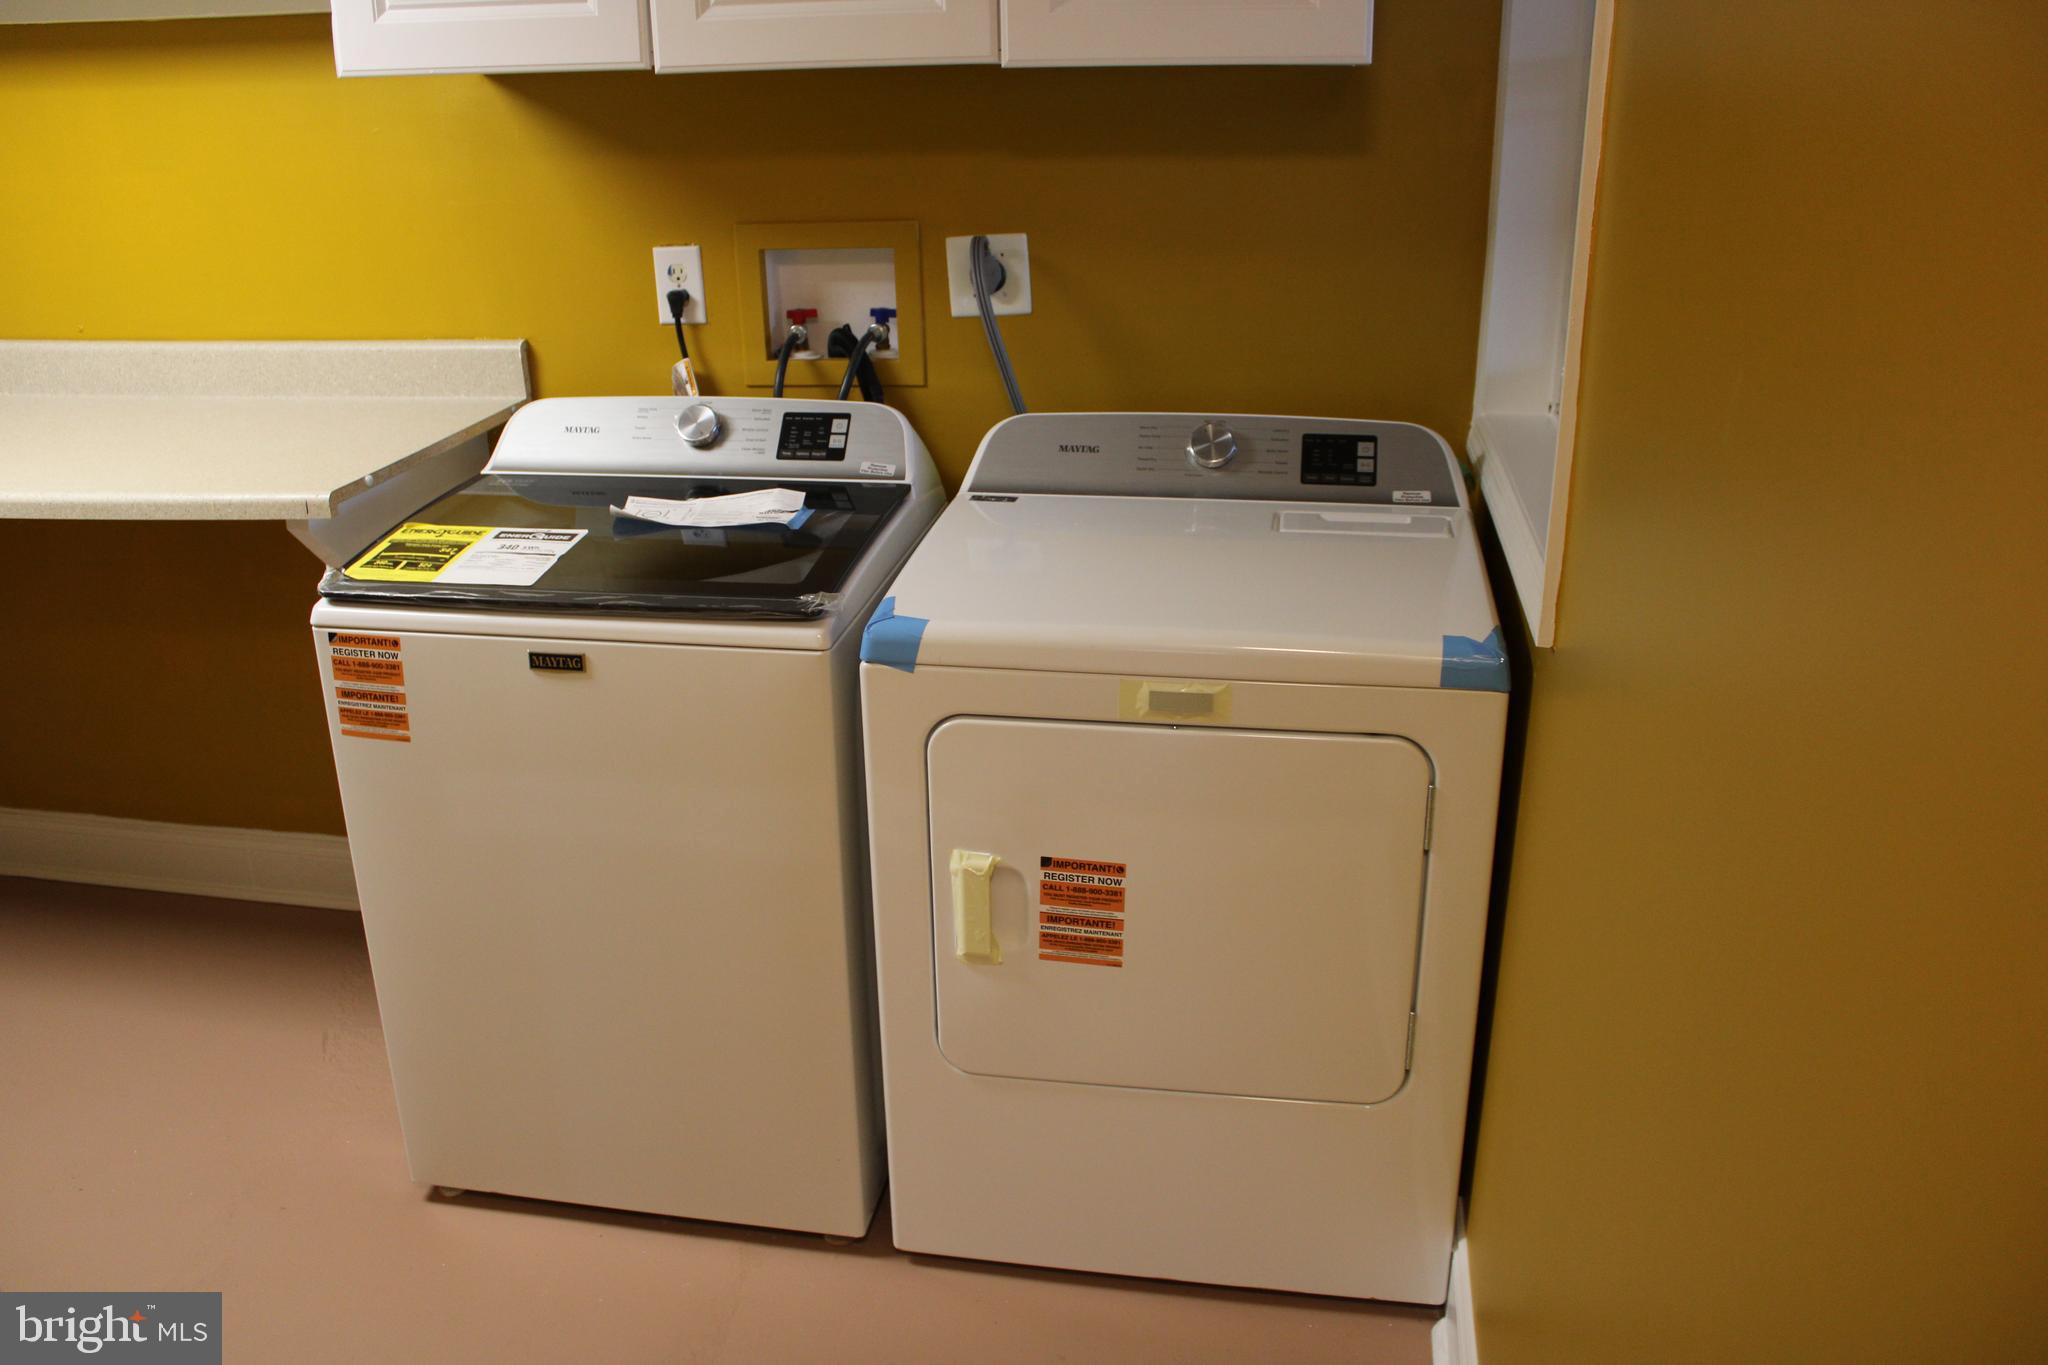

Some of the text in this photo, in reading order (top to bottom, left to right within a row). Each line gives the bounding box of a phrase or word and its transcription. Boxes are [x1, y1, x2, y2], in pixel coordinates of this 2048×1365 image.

[563, 425, 600, 434] MAYTAG
[1058, 444, 1100, 453] MAYTAG
[338, 635, 391, 647] IMPORTANT!
[332, 647, 399, 660] REGISTER NOW
[333, 659, 350, 667] CALL
[532, 655, 581, 668] MAYTAG
[341, 690, 399, 703] IMPORTANTE!
[1053, 860, 1116, 873] IMPORTANT!
[1043, 872, 1123, 887] REGISTER NOW
[1042, 884, 1065, 892] CALL
[1046, 915, 1116, 929] IMPORTANTE!
[1040, 925, 1122, 938] ENREGISTREZ MAINTENANT
